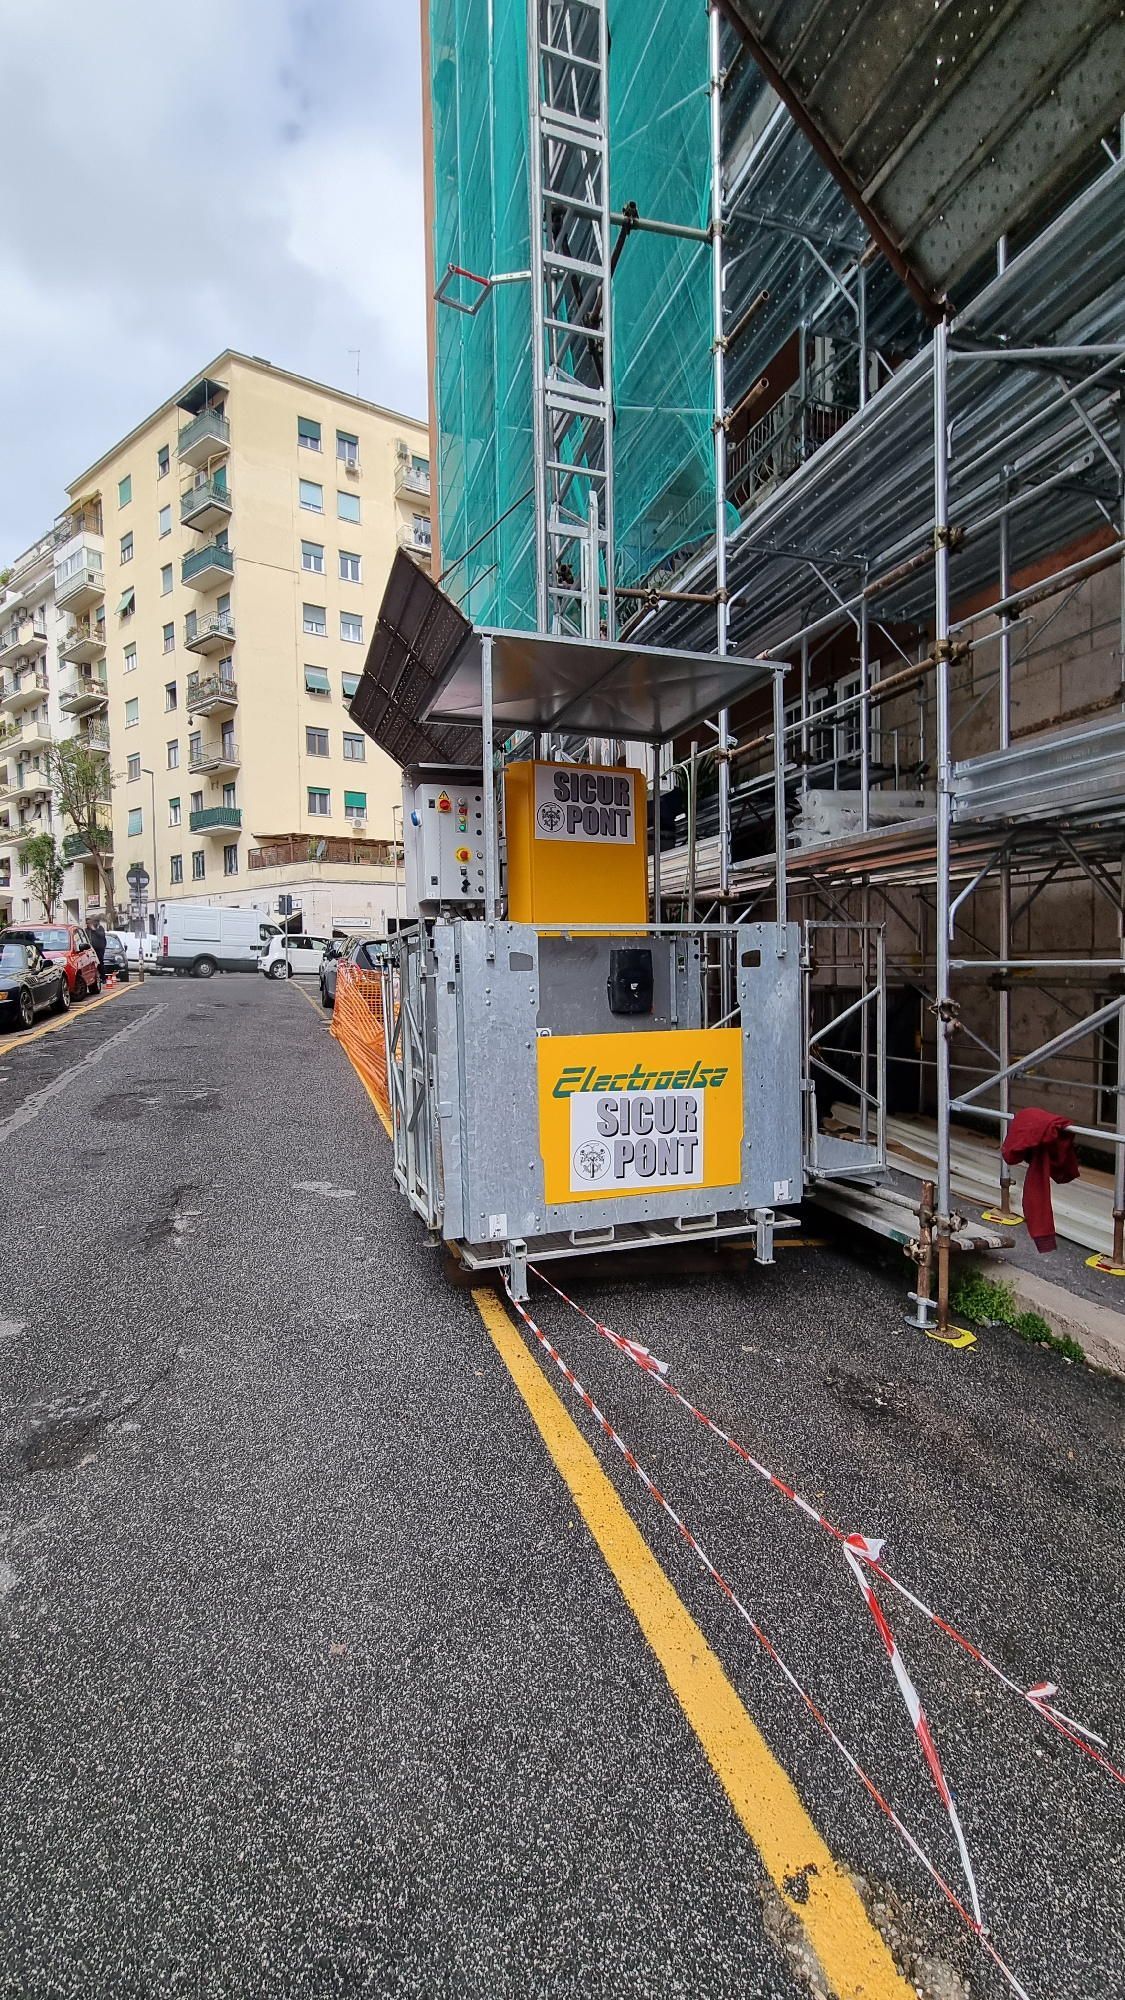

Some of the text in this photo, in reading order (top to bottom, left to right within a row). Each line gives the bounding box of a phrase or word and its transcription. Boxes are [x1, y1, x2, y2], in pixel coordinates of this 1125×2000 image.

[553, 771, 630, 807] SICUR
[566, 805, 631, 838] PONT
[552, 1060, 729, 1098] Electroelsa
[596, 1095, 698, 1137] SICUR
[613, 1136, 698, 1179] PONT
